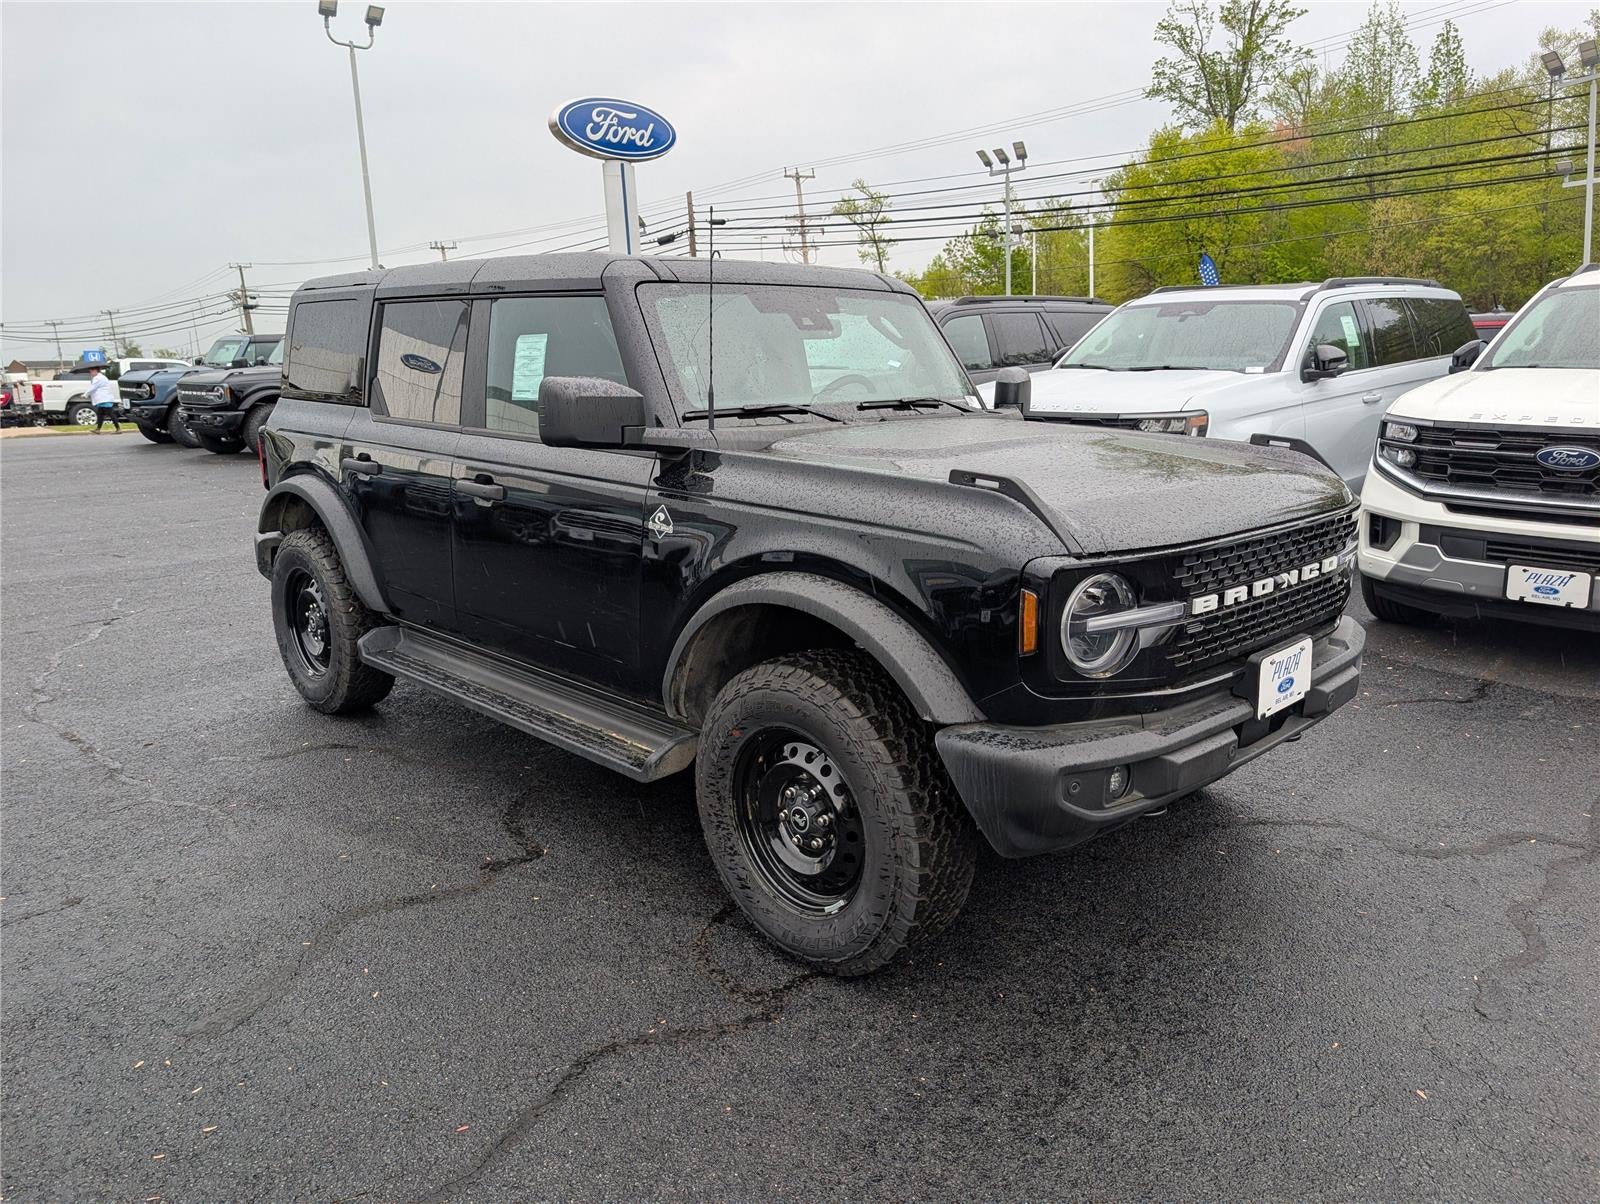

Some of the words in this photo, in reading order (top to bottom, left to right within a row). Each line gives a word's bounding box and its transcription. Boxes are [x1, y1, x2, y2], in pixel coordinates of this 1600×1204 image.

[586, 107, 655, 148] Ford
[1547, 449, 1589, 467] Ford
[1191, 555, 1338, 615] BRONCO
[1525, 572, 1574, 588] PLAZA
[1271, 651, 1302, 682] PLAZA
